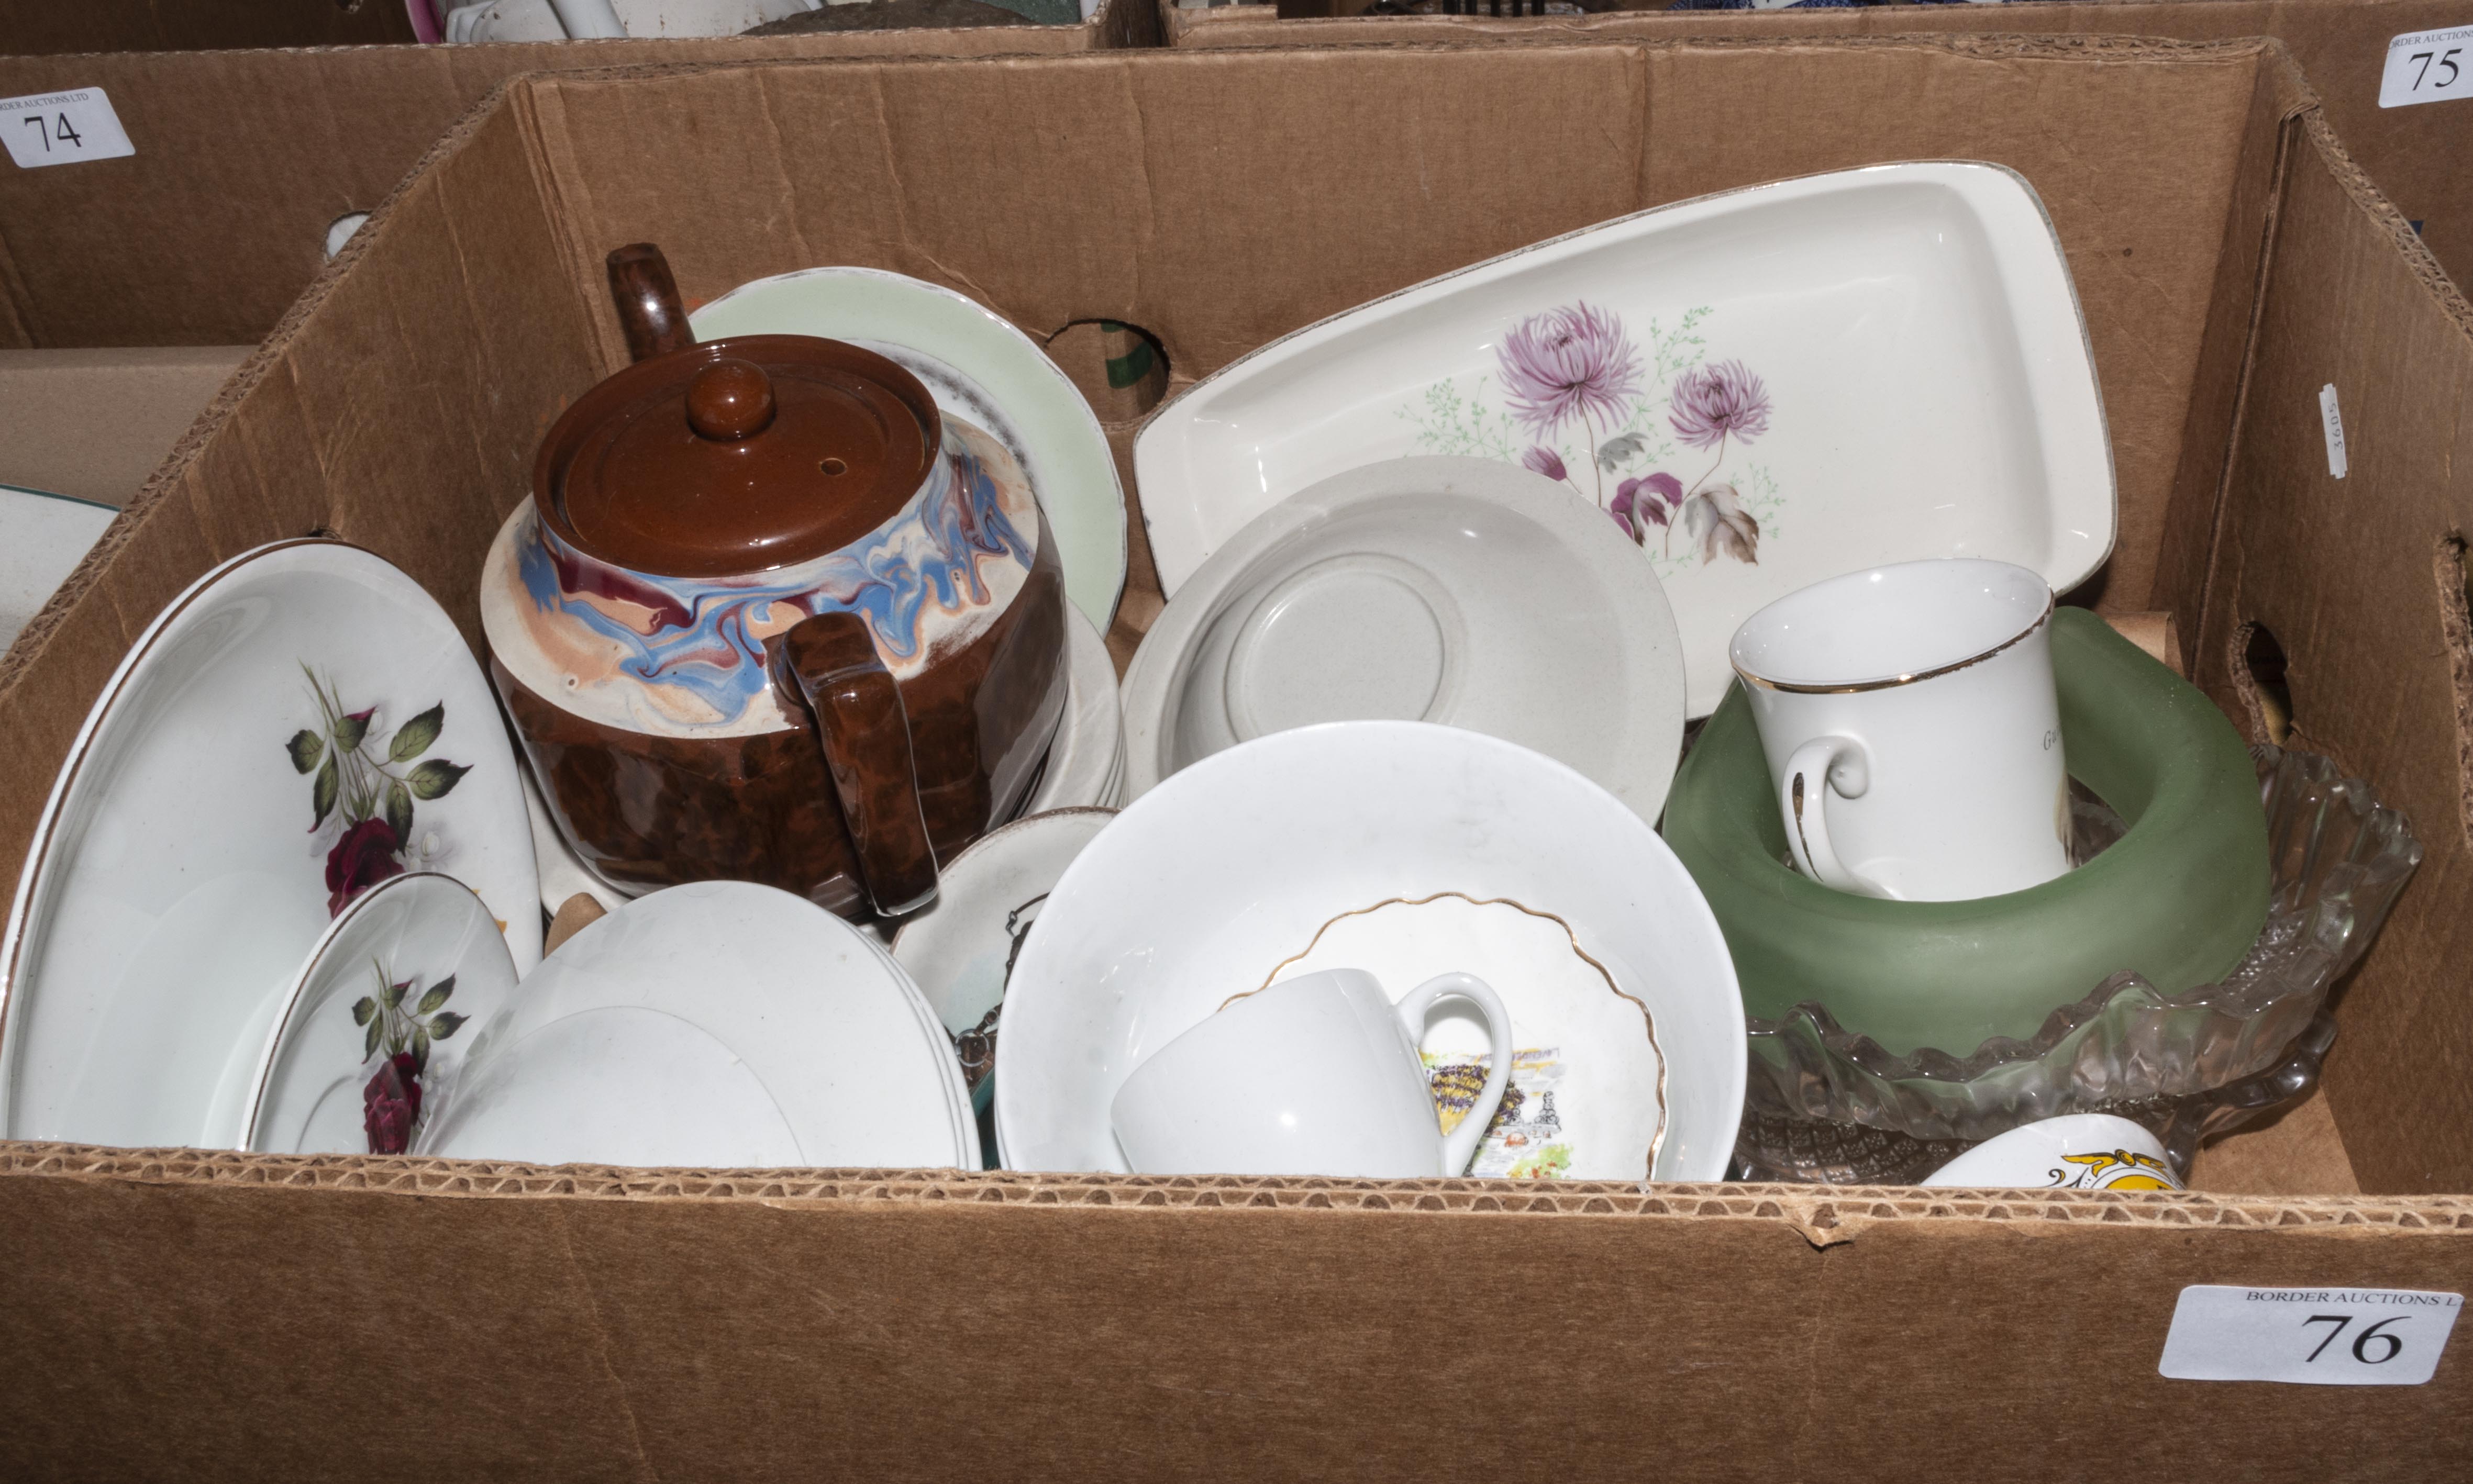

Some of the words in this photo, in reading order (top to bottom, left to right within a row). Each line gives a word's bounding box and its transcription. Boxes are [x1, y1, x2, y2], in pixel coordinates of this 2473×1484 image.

[2423, 30, 2473, 43] AUCTION
[2409, 48, 2463, 91] 75
[24, 95, 70, 108] AUCTIONS
[70, 93, 89, 102] LTD
[25, 113, 81, 151] 74
[2328, 403, 2343, 449] 3605
[2246, 1291, 2330, 1302] BORDER
[2334, 1293, 2441, 1306] AUCTIONS
[2302, 1314, 2412, 1364] 76
